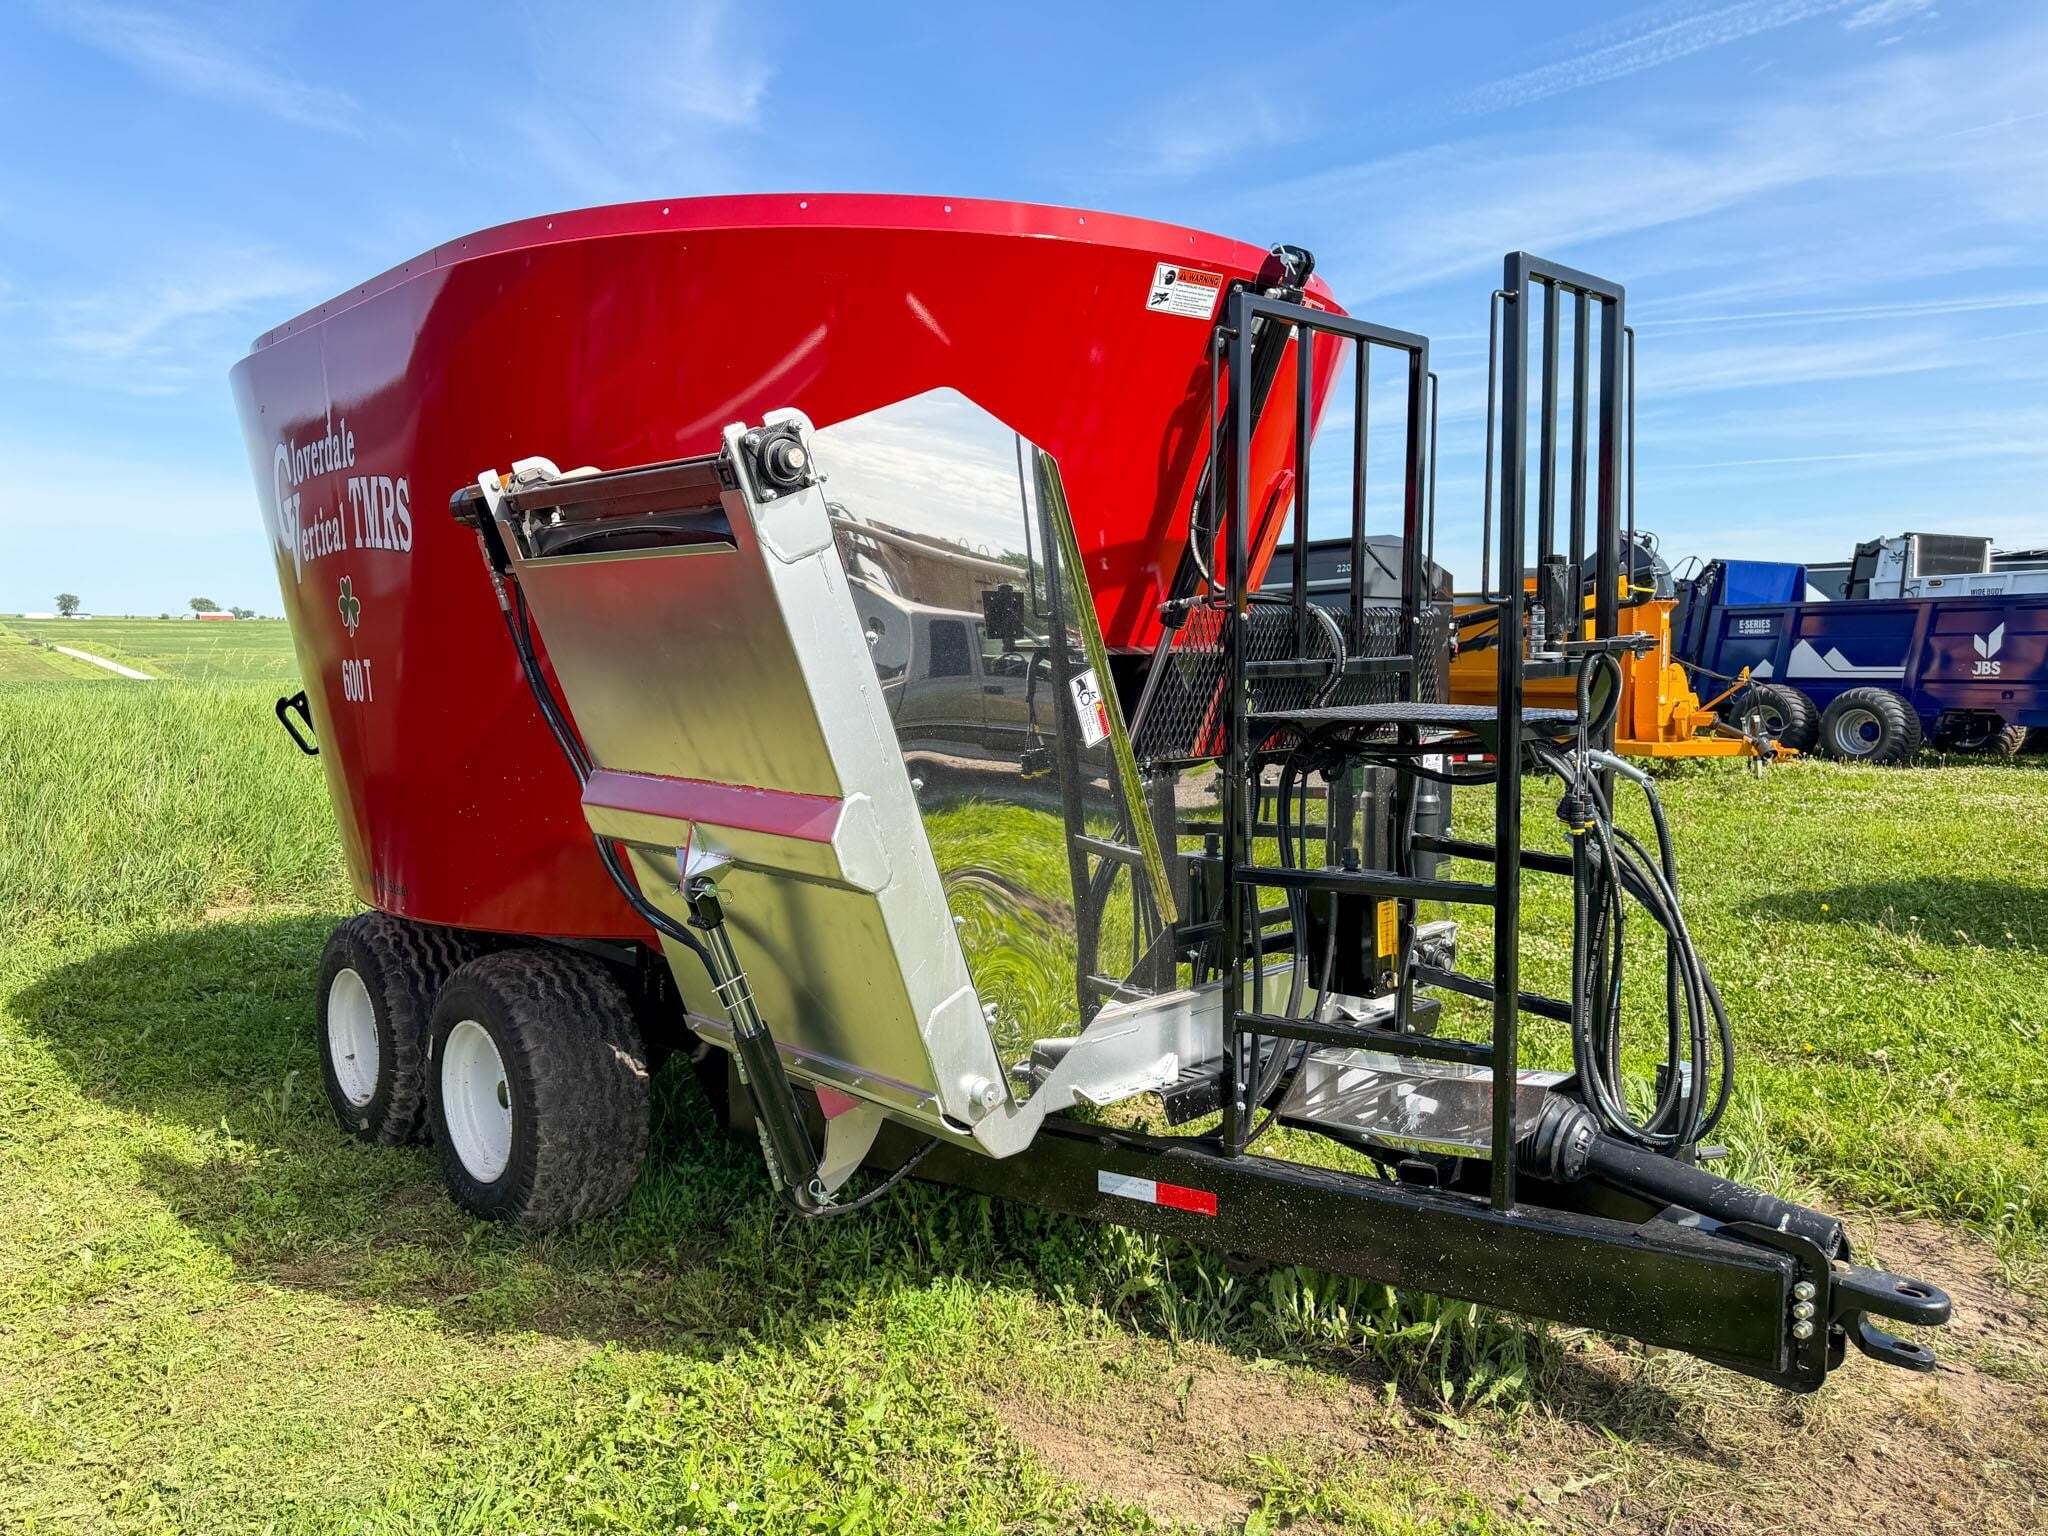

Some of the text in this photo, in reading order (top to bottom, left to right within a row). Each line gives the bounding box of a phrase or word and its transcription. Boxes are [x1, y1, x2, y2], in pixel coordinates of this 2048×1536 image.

[1190, 271, 1218, 286] WARNING
[281, 476, 413, 584] Vertical TMRS
[1986, 587, 2003, 595] BODY
[1739, 619, 1770, 629] E-SERIES
[1971, 660, 2001, 675] JBS
[342, 659, 373, 702] 600 T
